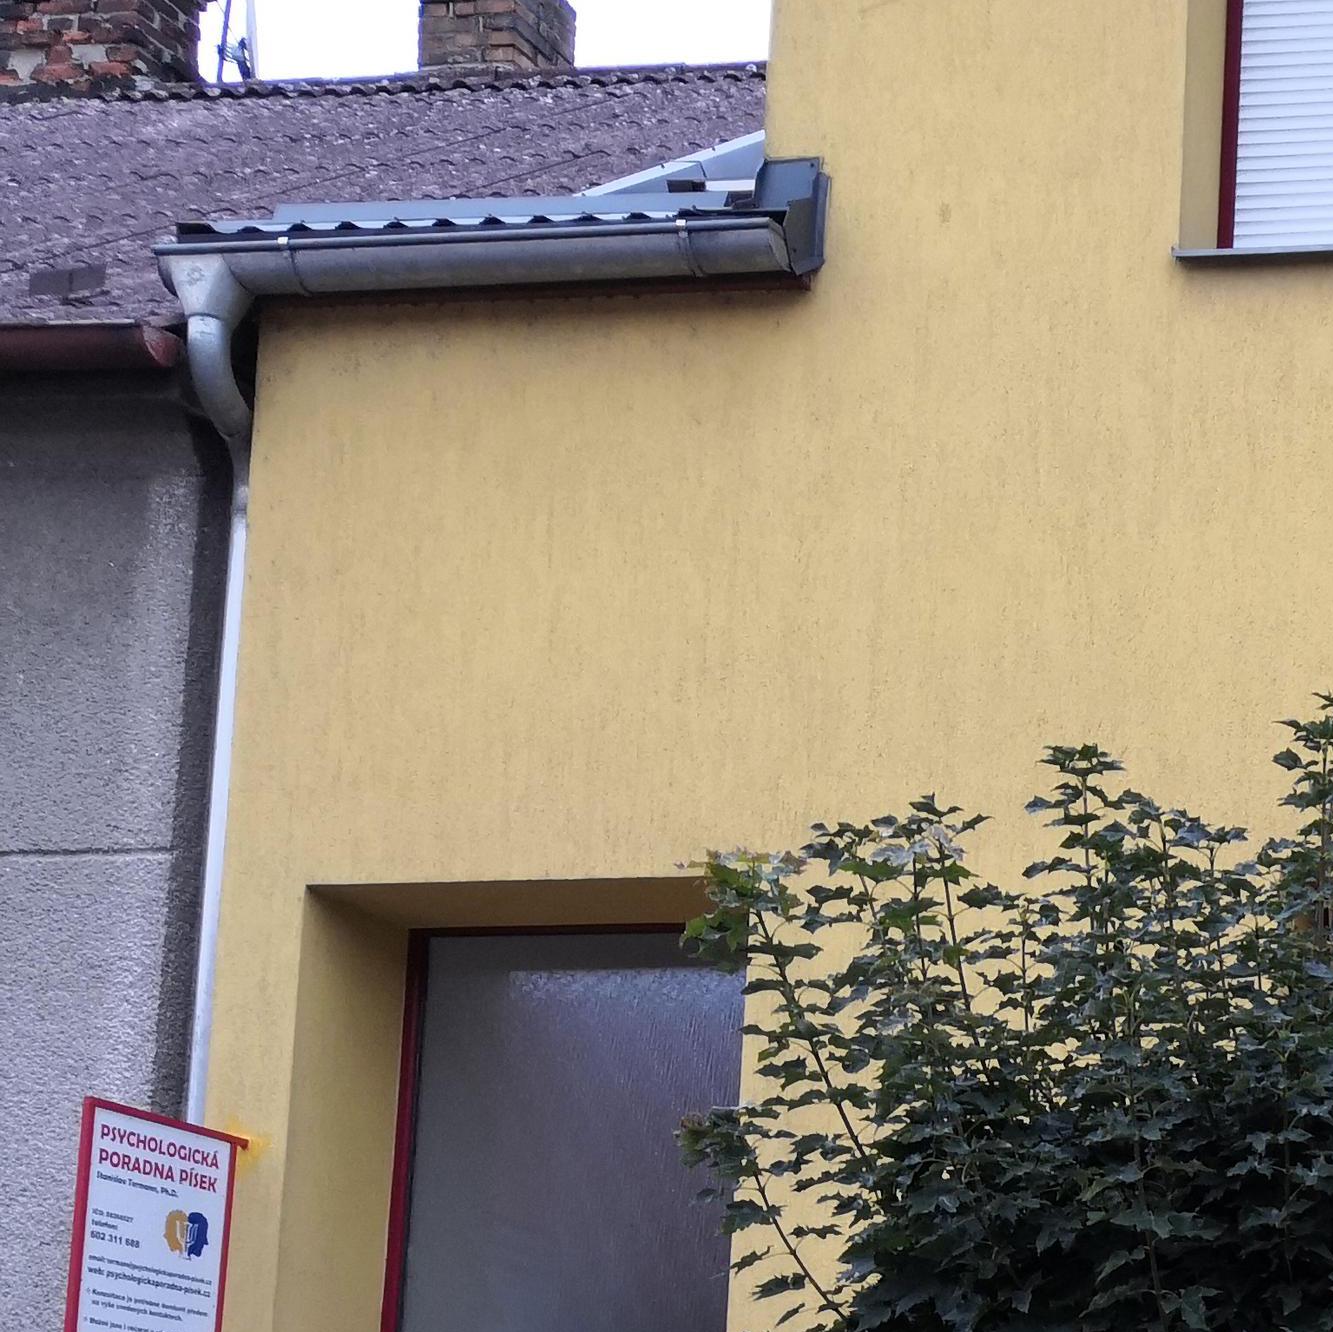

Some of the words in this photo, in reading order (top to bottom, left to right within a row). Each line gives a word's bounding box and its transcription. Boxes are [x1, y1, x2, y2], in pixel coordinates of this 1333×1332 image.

[100, 1123, 219, 1169] PSYCHOLOGICKÁ
[98, 1148, 175, 1182] PORADNA
[179, 1166, 218, 1193] PÍSEK
[107, 1234, 122, 1244] 311
